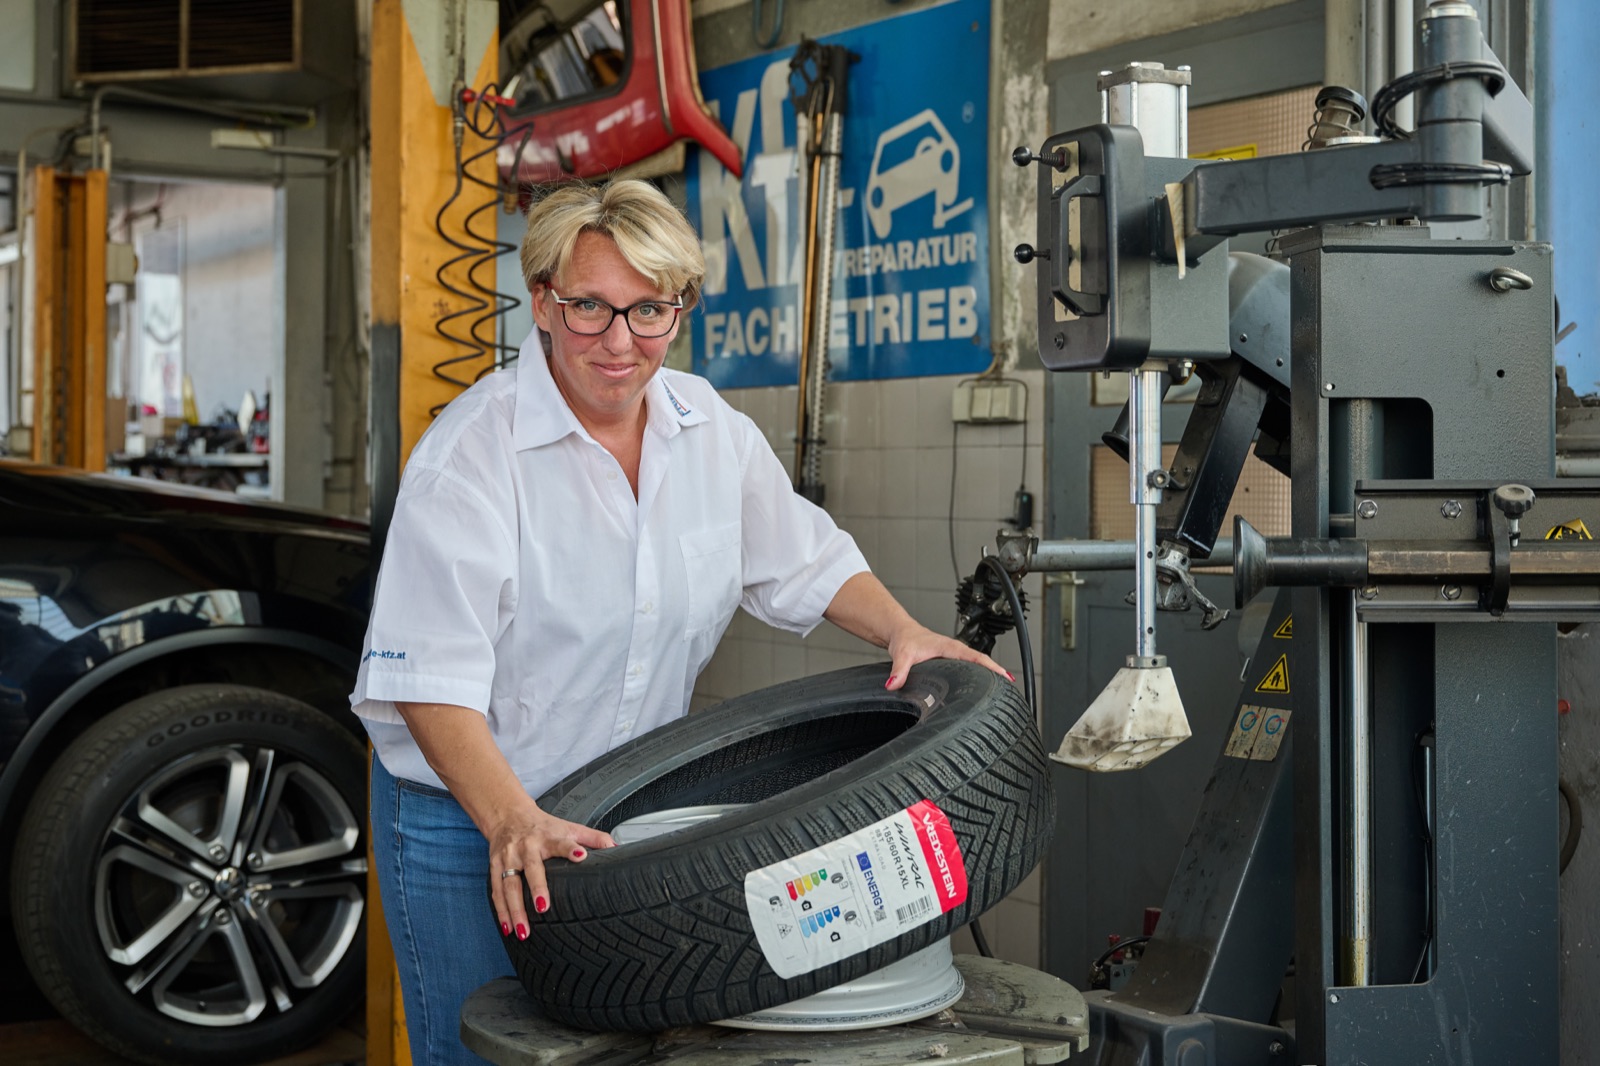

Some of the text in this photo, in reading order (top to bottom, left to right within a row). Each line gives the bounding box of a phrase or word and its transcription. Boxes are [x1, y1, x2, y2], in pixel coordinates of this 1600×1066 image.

[843, 232, 977, 279] REPARATUR
[704, 285, 978, 359] FACHETRIEB
[893, 821, 925, 890] WINTRAC
[922, 812, 958, 900] VREDESTEIN
